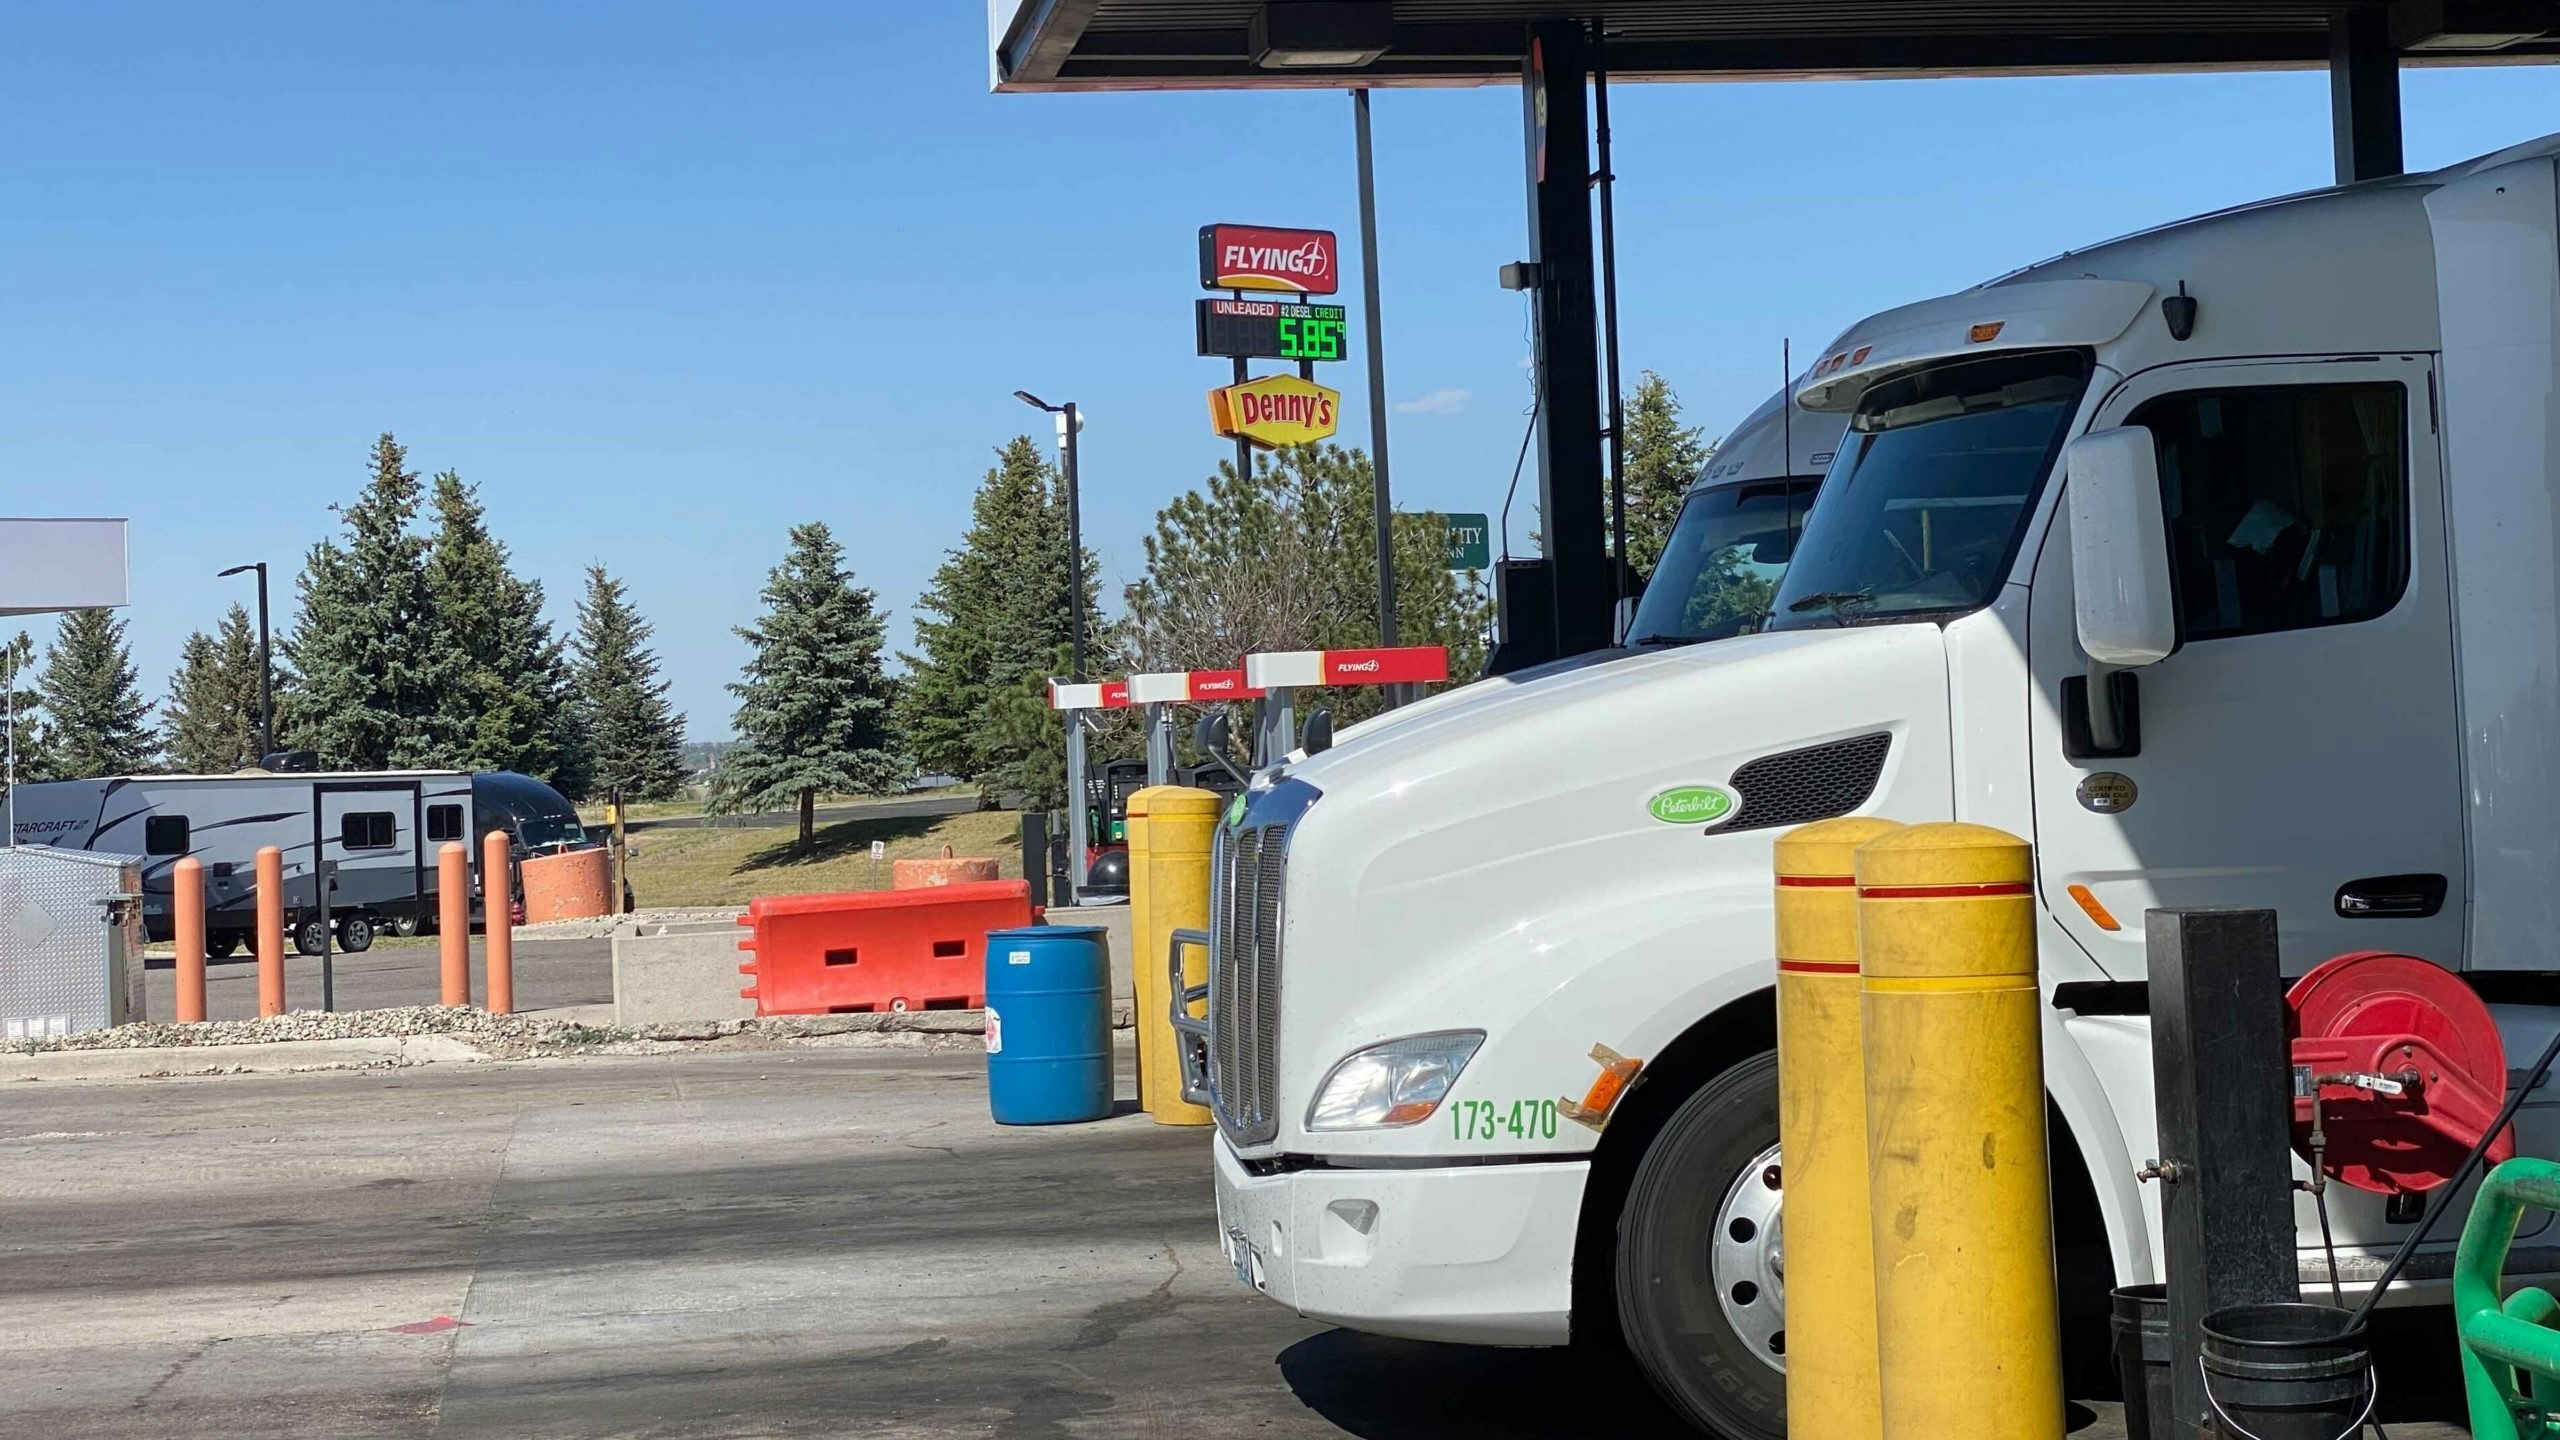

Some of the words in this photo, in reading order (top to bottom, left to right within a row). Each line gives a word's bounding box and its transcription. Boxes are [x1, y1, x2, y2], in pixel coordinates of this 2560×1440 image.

[1216, 301, 1274, 316] UNLEADED
[1290, 306, 1312, 318] DIESEL
[1315, 308, 1344, 319] CREDIT
[1241, 392, 1332, 429] Denny's
[1660, 796, 1722, 815] Peterbilt
[13, 820, 77, 833] STARCRAFT
[1450, 1099, 1557, 1141] 173-470
